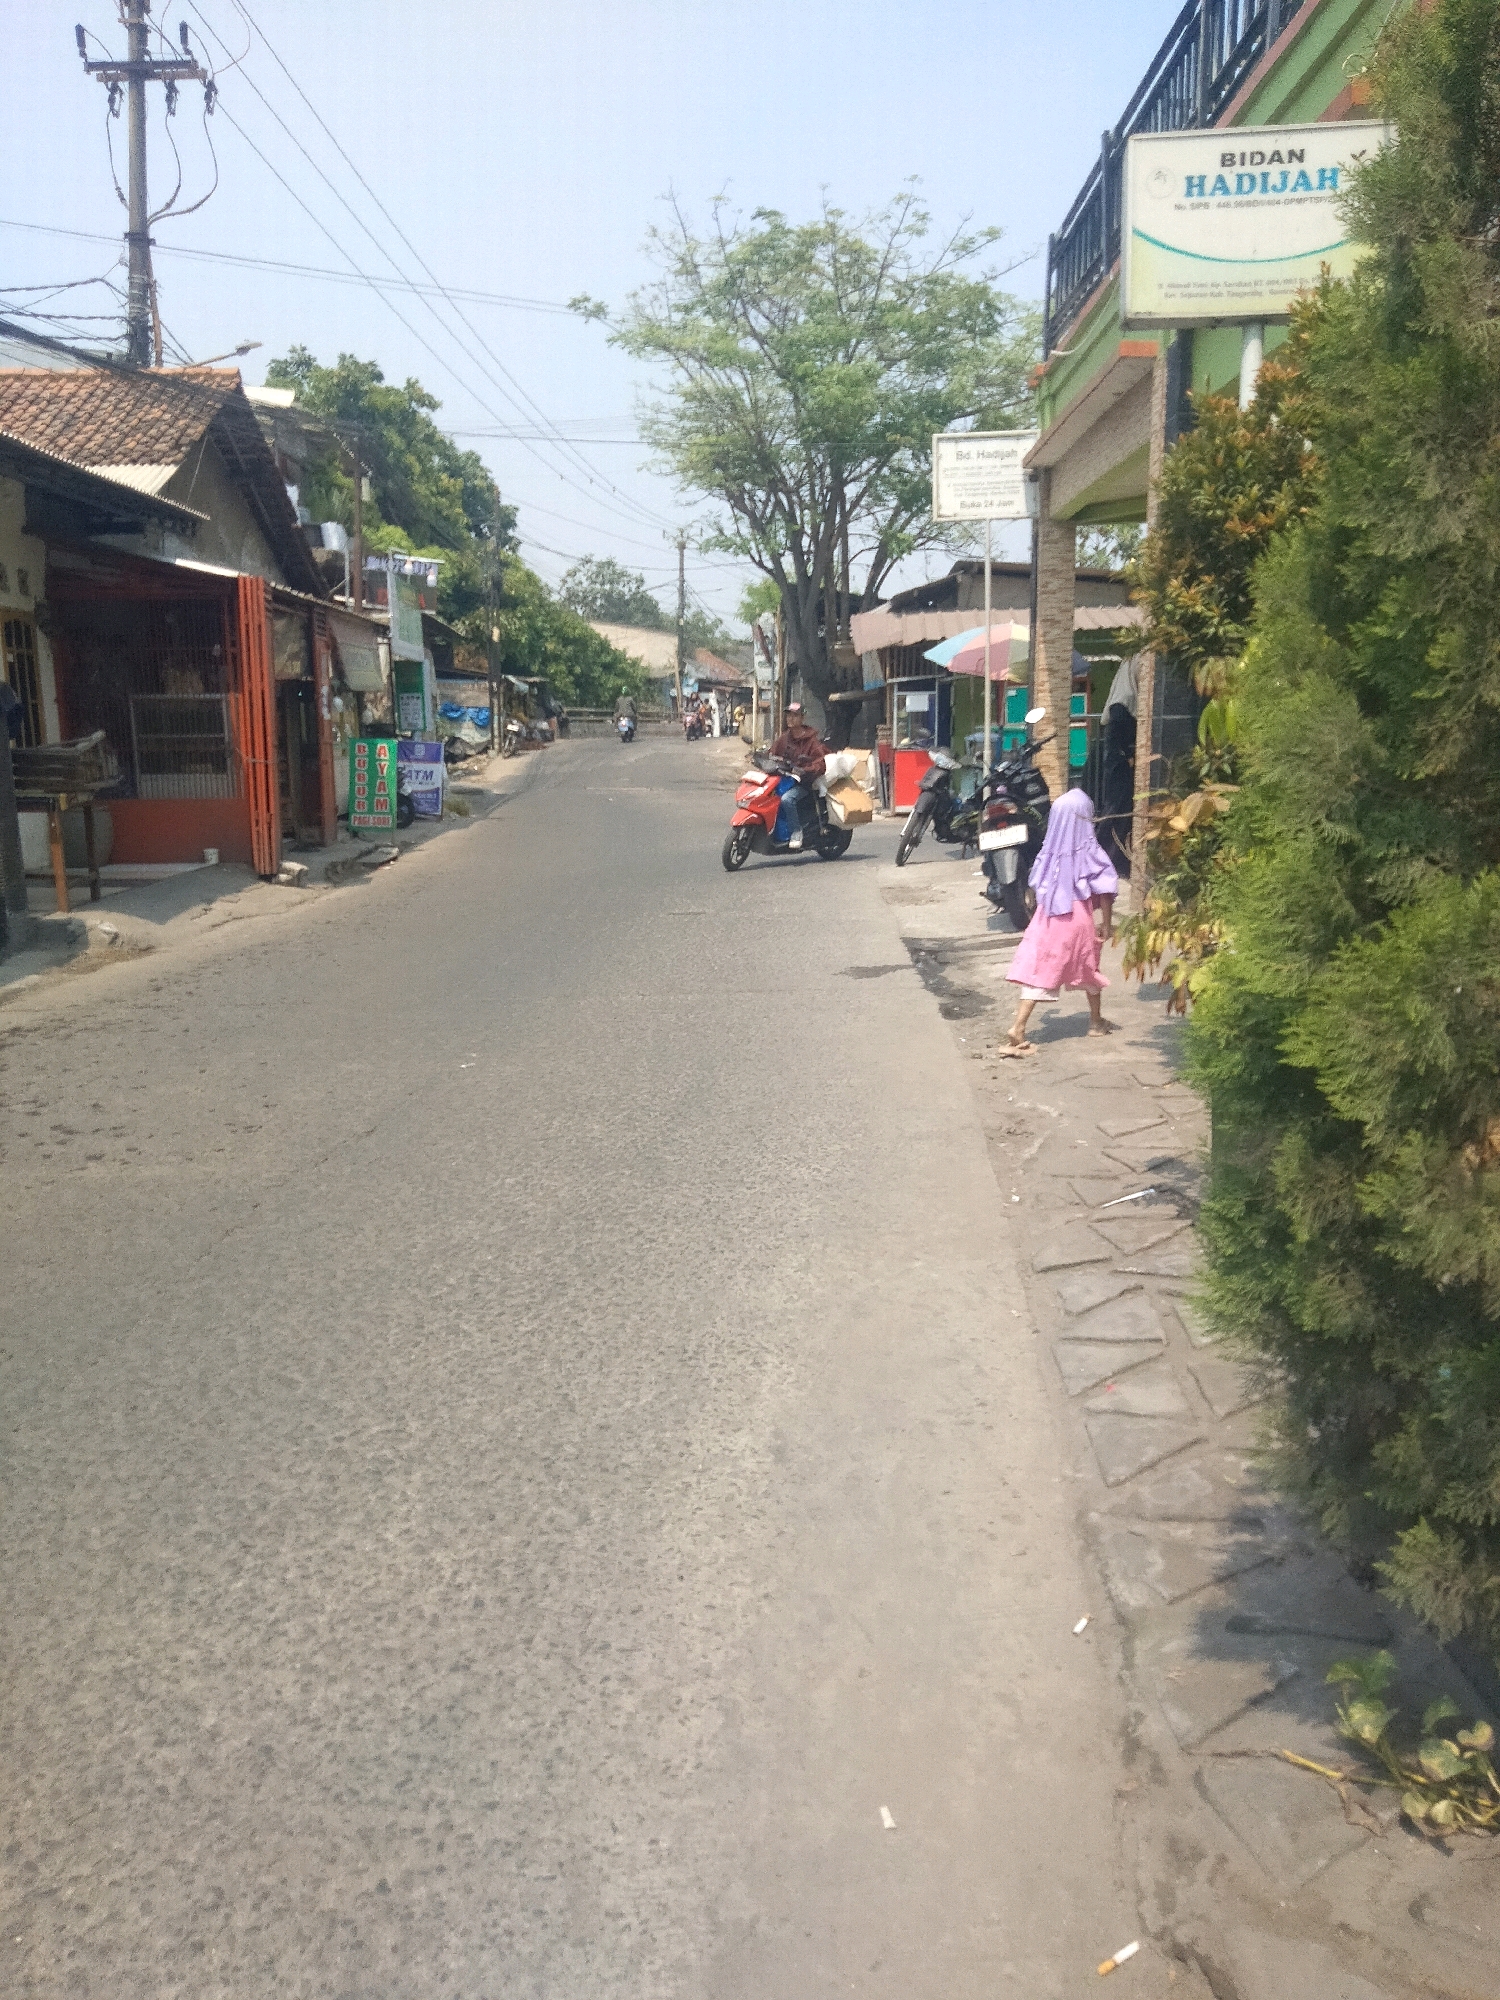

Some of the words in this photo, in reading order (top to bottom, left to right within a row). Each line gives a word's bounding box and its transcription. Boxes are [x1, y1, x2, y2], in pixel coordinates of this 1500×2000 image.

[1220, 149, 1305, 168] BIDAN
[1184, 167, 1340, 198] HADIJAH
[977, 449, 1018, 460] Hadijah
[960, 500, 982, 509] Buka
[984, 500, 993, 508] 24
[356, 743, 368, 812] BUBUR
[375, 744, 389, 812] AYAM
[405, 769, 434, 781] ATM
